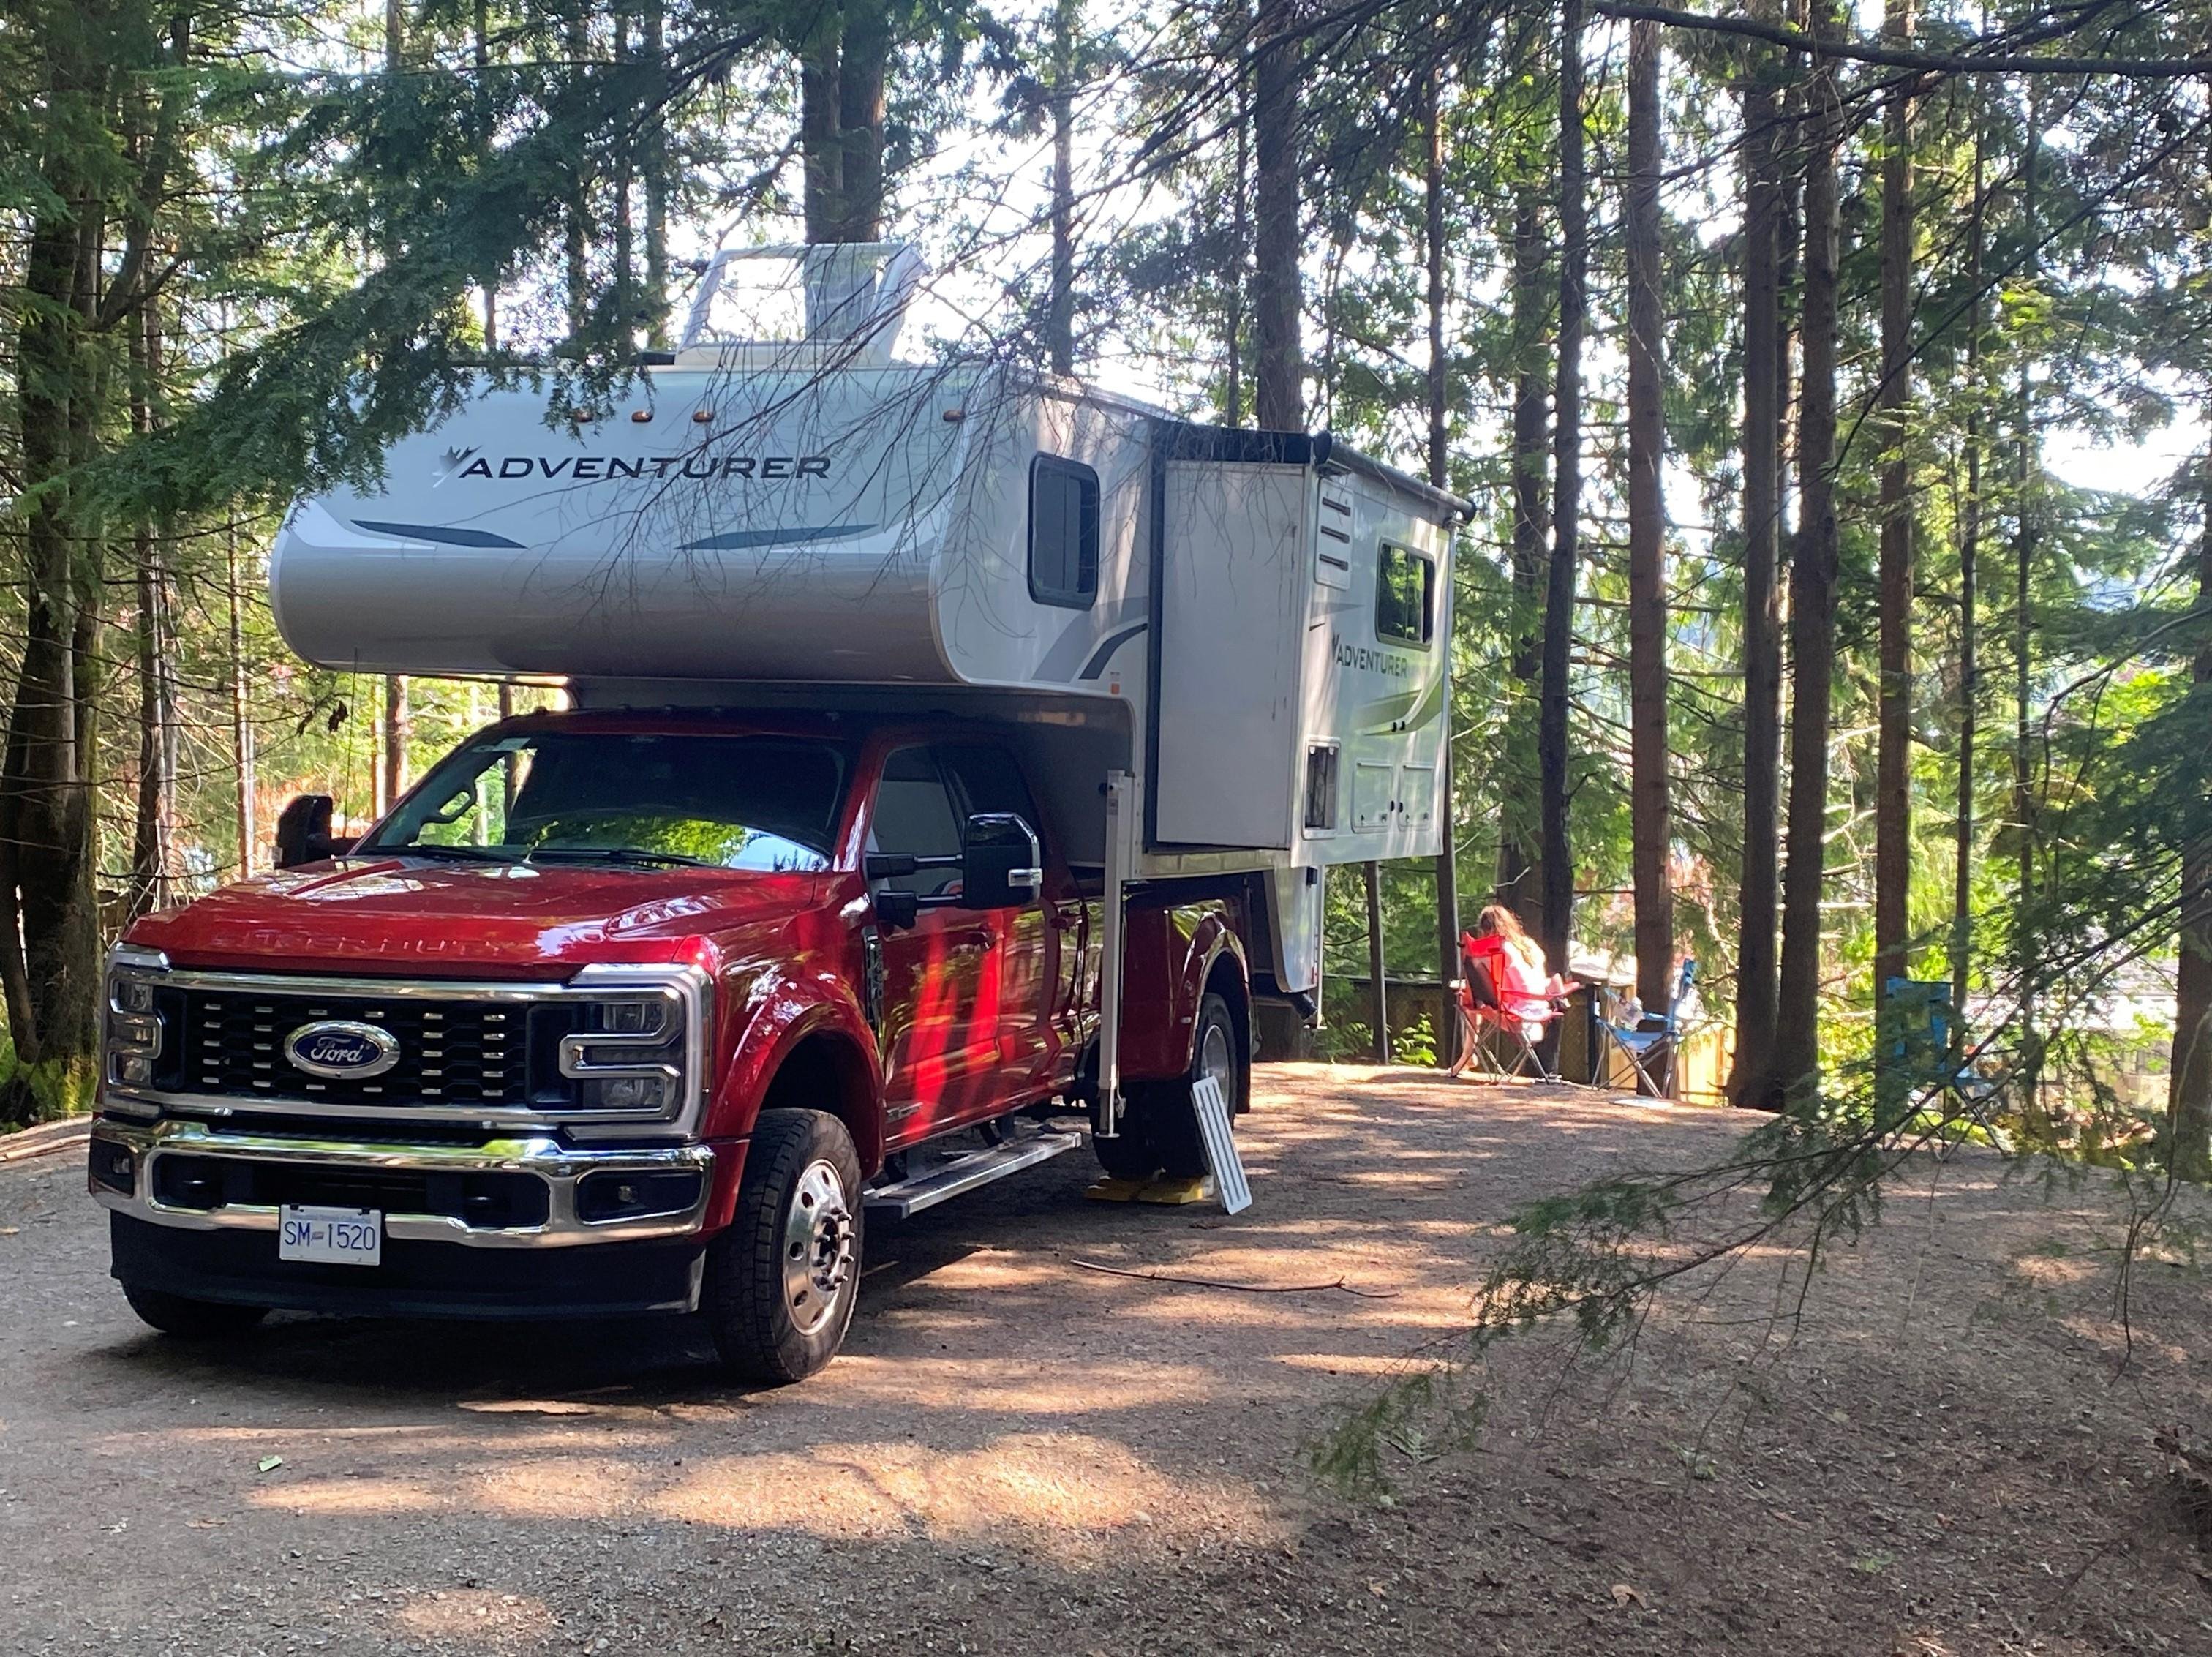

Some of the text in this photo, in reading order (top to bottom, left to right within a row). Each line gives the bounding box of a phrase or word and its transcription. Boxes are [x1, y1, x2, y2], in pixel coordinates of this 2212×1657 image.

[459, 457, 831, 479] ADVENTURER
[1336, 644, 1407, 679] ADVENTURER
[310, 1036, 364, 1062] Ford
